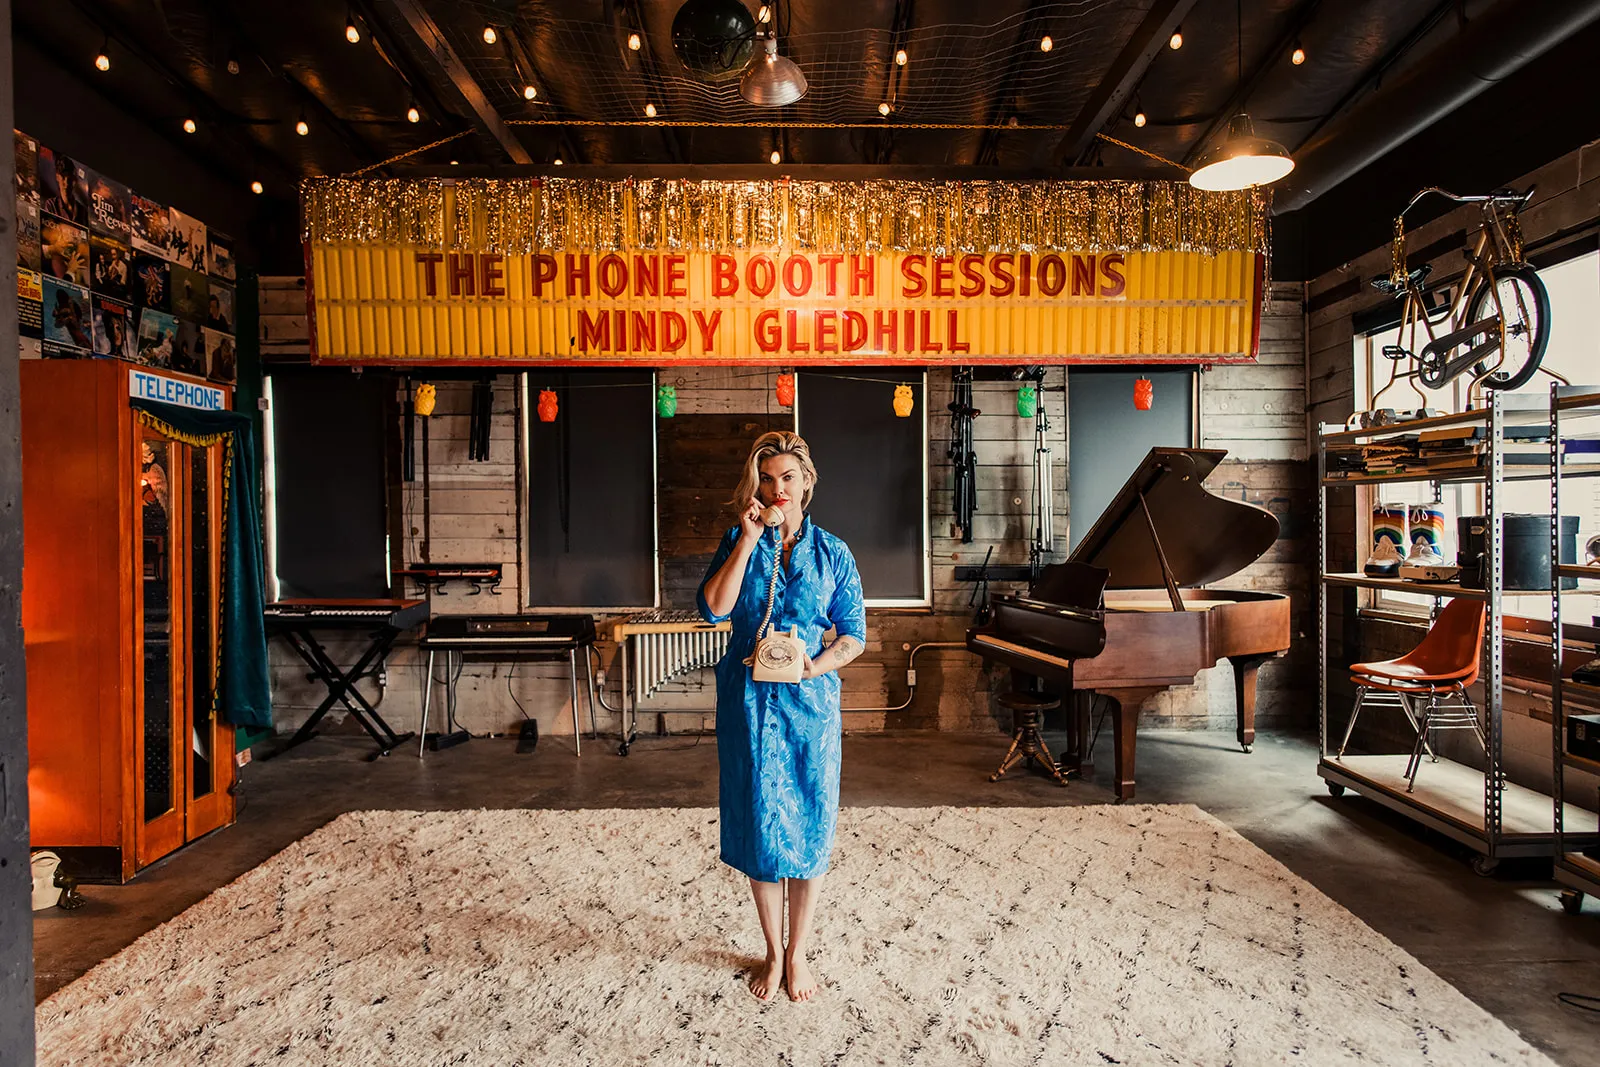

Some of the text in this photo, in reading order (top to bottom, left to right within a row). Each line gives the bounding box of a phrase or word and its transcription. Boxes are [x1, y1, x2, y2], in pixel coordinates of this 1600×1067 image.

[92, 193, 113, 213] Jim
[94, 207, 130, 232] Reeves
[416, 253, 1125, 298] THE PHONE BOOTH SESSIONS
[577, 310, 970, 352] MINDY GLEDHILL
[135, 373, 221, 410] TELEPHONE
